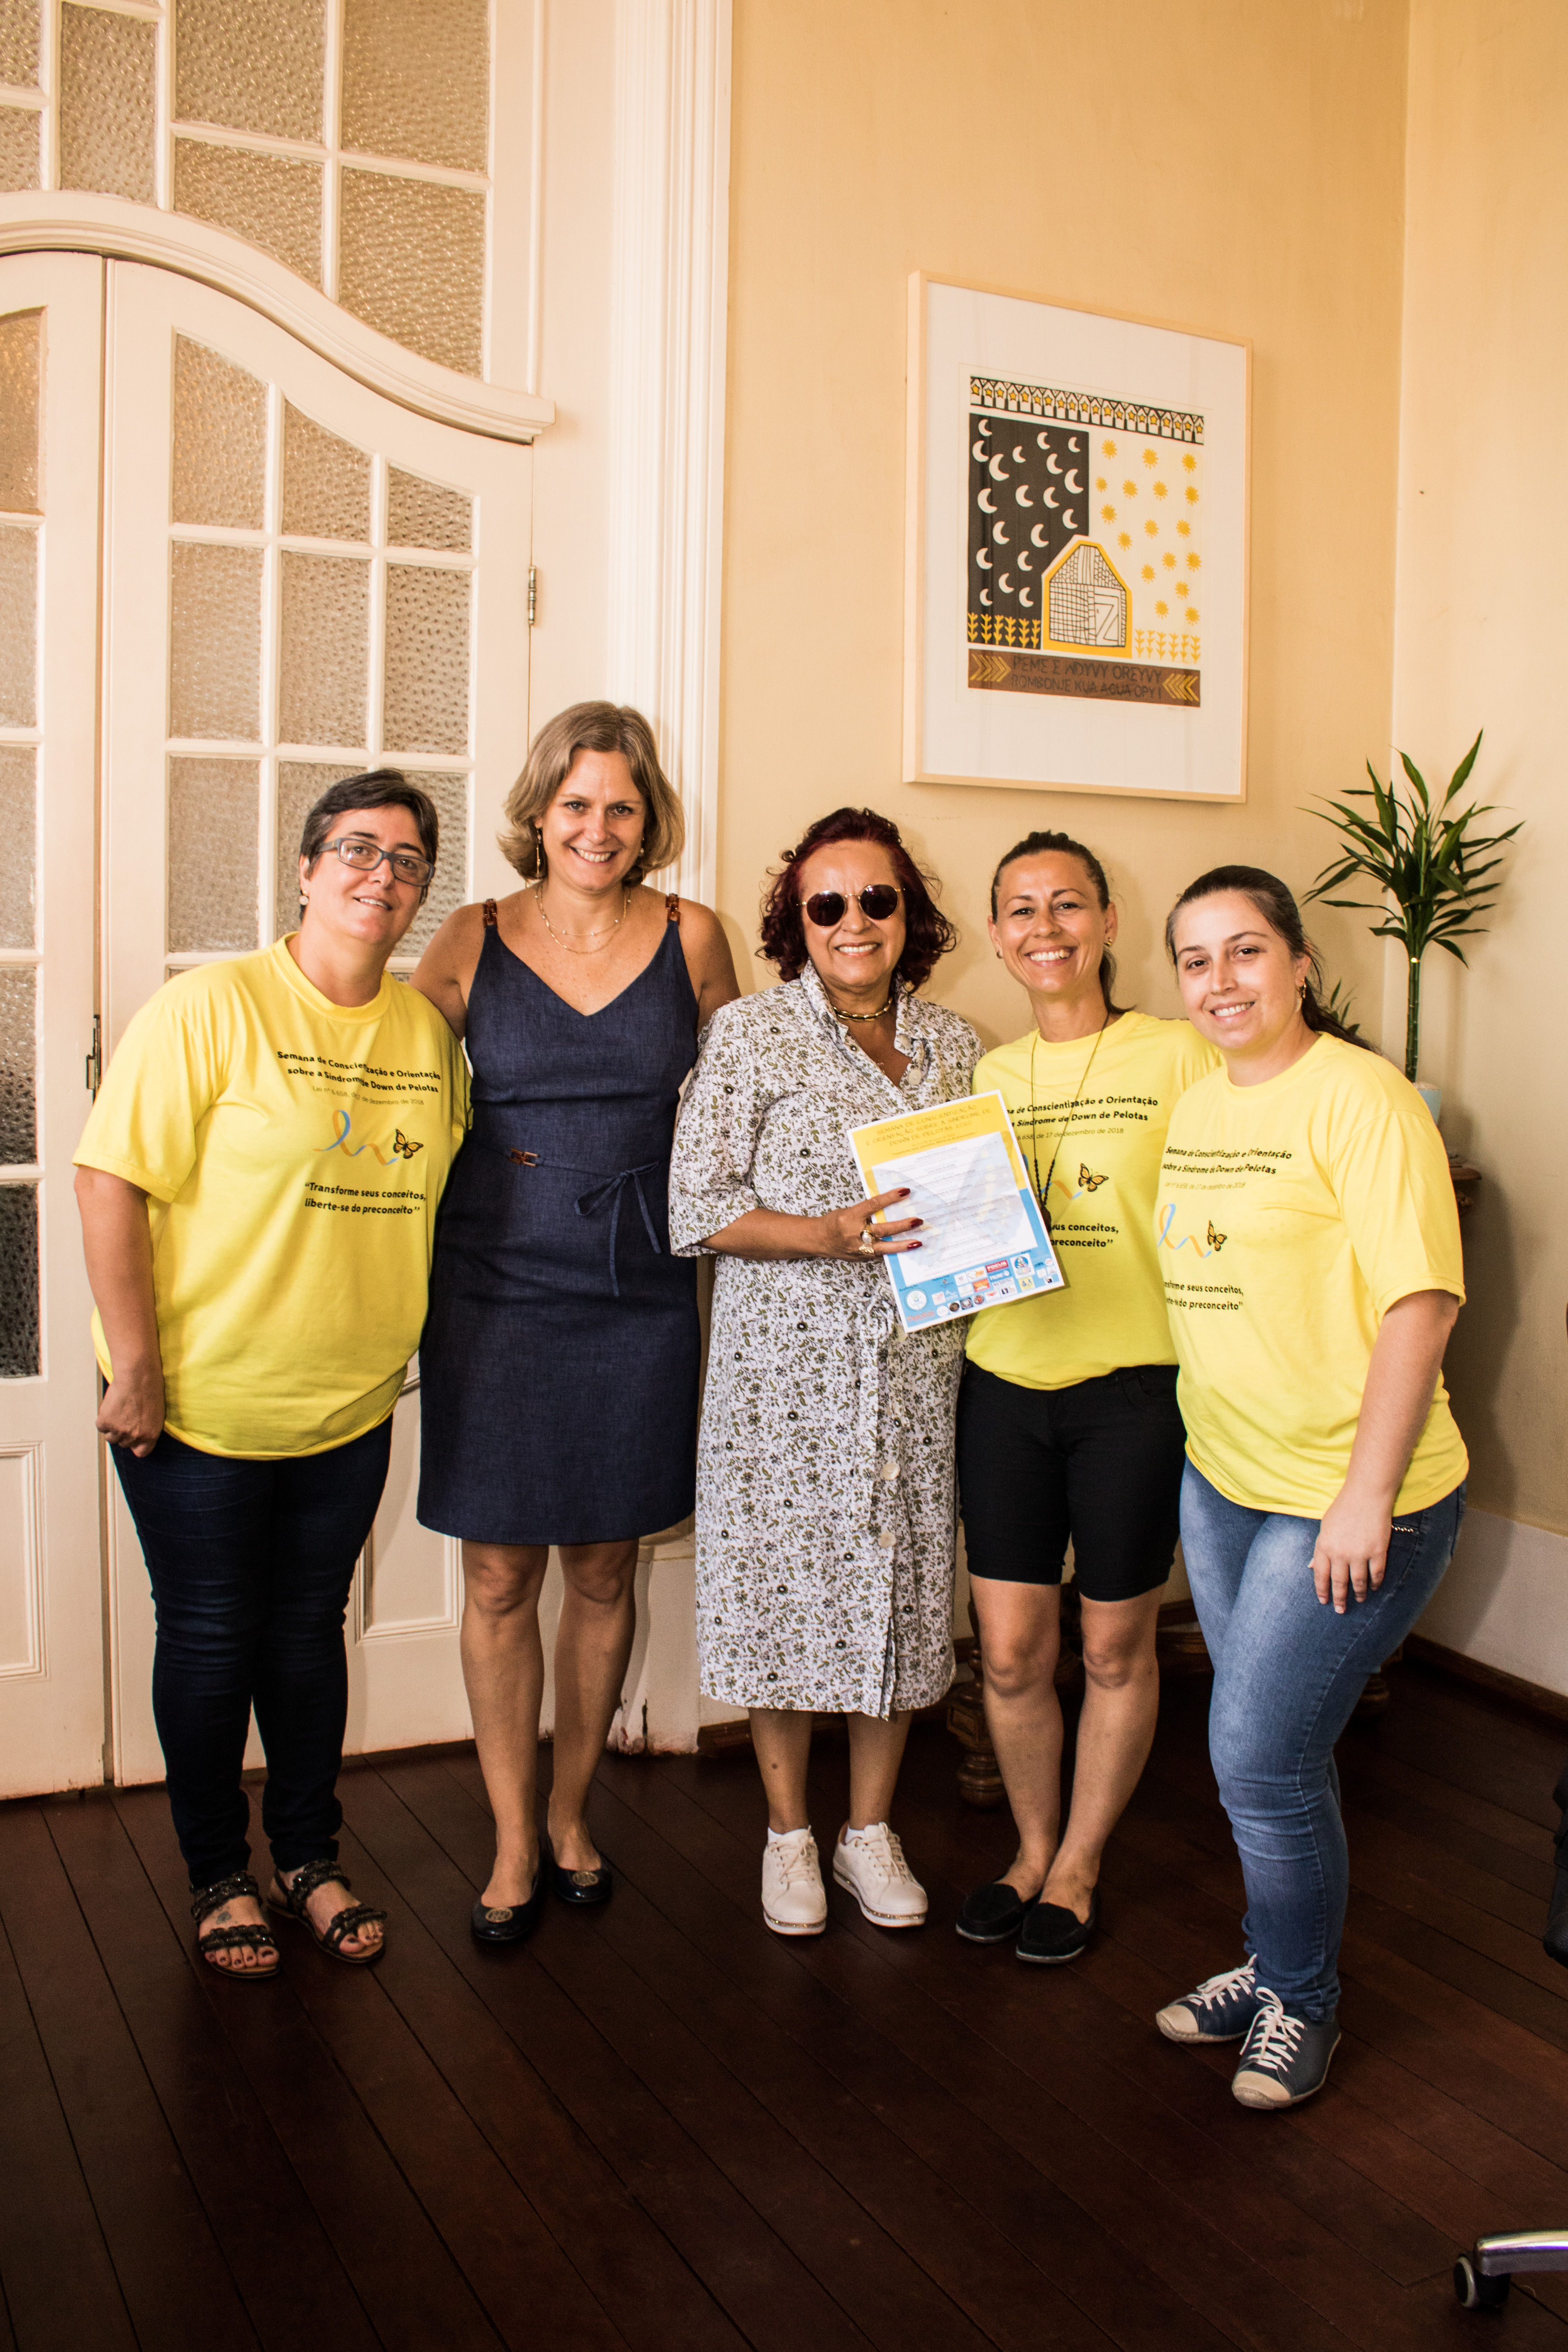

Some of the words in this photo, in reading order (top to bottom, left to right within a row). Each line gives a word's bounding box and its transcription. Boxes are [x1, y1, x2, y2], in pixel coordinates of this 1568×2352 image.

[277, 1051, 315, 1062] Semana
[318, 1056, 327, 1065] de
[329, 1059, 388, 1076] Consciezação
[396, 1070, 441, 1080] Orientação
[288, 1067, 315, 1077] sobre
[370, 1080, 394, 1090] Down
[408, 1083, 439, 1093] Pelotas
[1027, 1097, 1095, 1112] Conscientização
[1106, 1096, 1158, 1106] Orientação
[1071, 1113, 1097, 1121] Down
[1099, 1111, 1110, 1119] de
[1113, 1110, 1148, 1121] Pelotas
[877, 1124, 903, 1135] SEMANA
[916, 1122, 938, 1132] SOBRE
[889, 1136, 910, 1146] DOWN
[923, 1126, 953, 1138] PELOTAS
[1165, 1146, 1187, 1156] Semana
[1162, 1162, 1177, 1171] sobre
[1216, 1164, 1234, 1173] Down
[1243, 1163, 1277, 1174] Pelotas
[361, 1189, 379, 1197] seus
[381, 1190, 426, 1202] conceitos,
[304, 1198, 349, 1212] liberte-se
[351, 1203, 361, 1212] do
[1068, 1223, 1119, 1234] conceitos,
[1205, 1284, 1244, 1297] conceitos,
[1179, 1298, 1187, 1307] do
